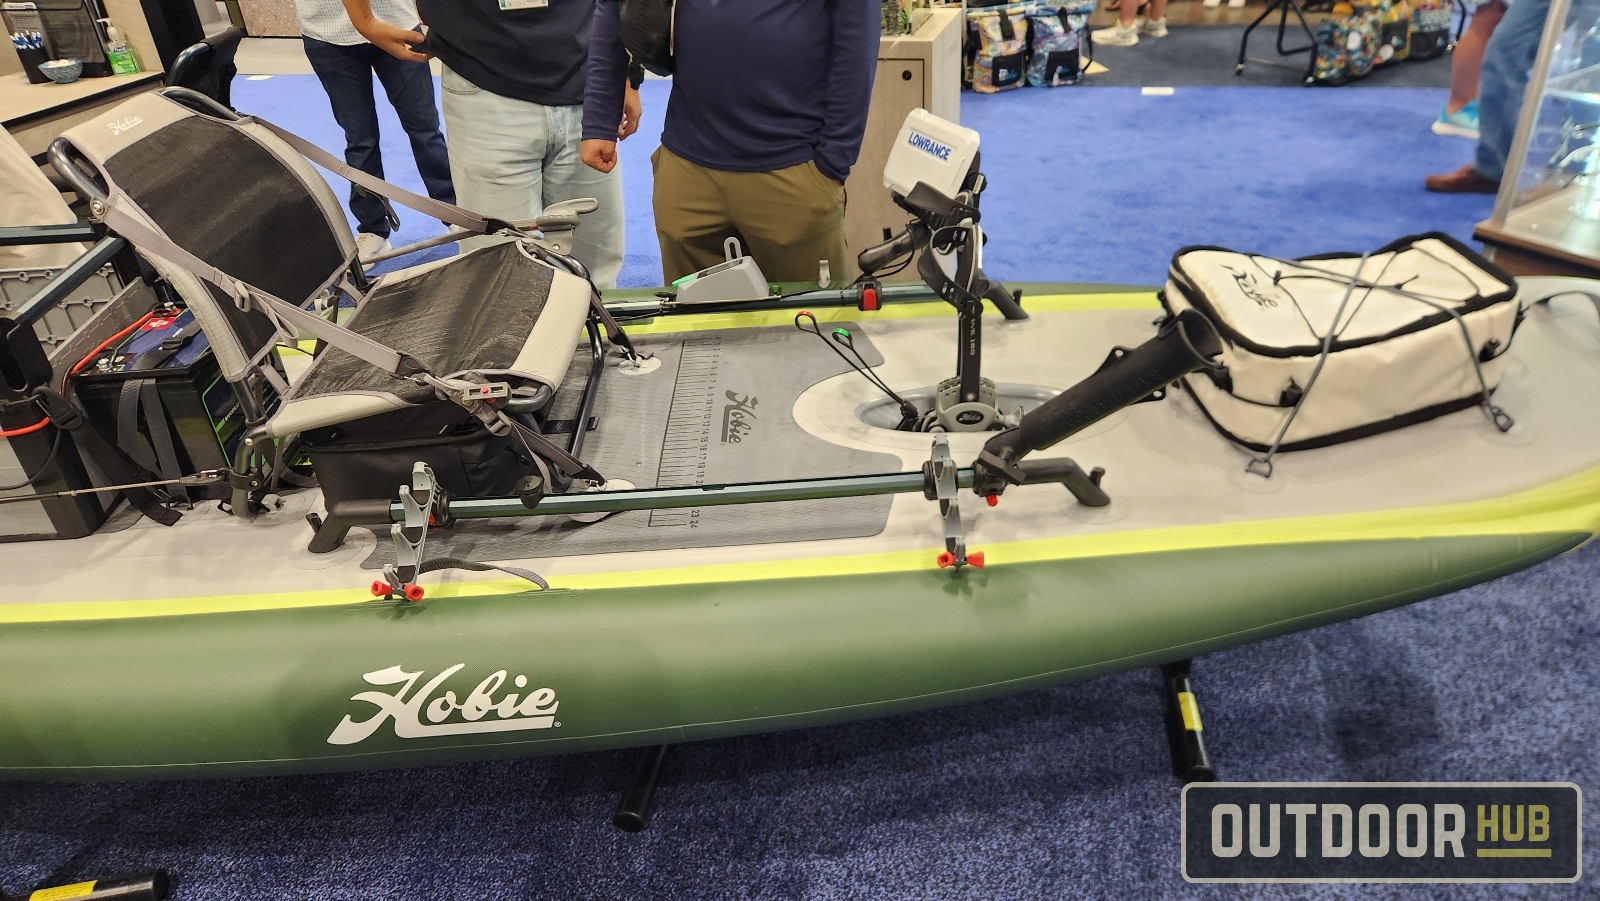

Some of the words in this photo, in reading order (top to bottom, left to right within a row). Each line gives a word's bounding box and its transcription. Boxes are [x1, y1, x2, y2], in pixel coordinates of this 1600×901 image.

[106, 116, 144, 136] Hobie
[908, 132, 952, 160] LOWRANCE
[721, 390, 758, 443] Hobie
[690, 510, 700, 518] 23
[690, 520, 698, 528] 24
[326, 663, 560, 744] Hobie
